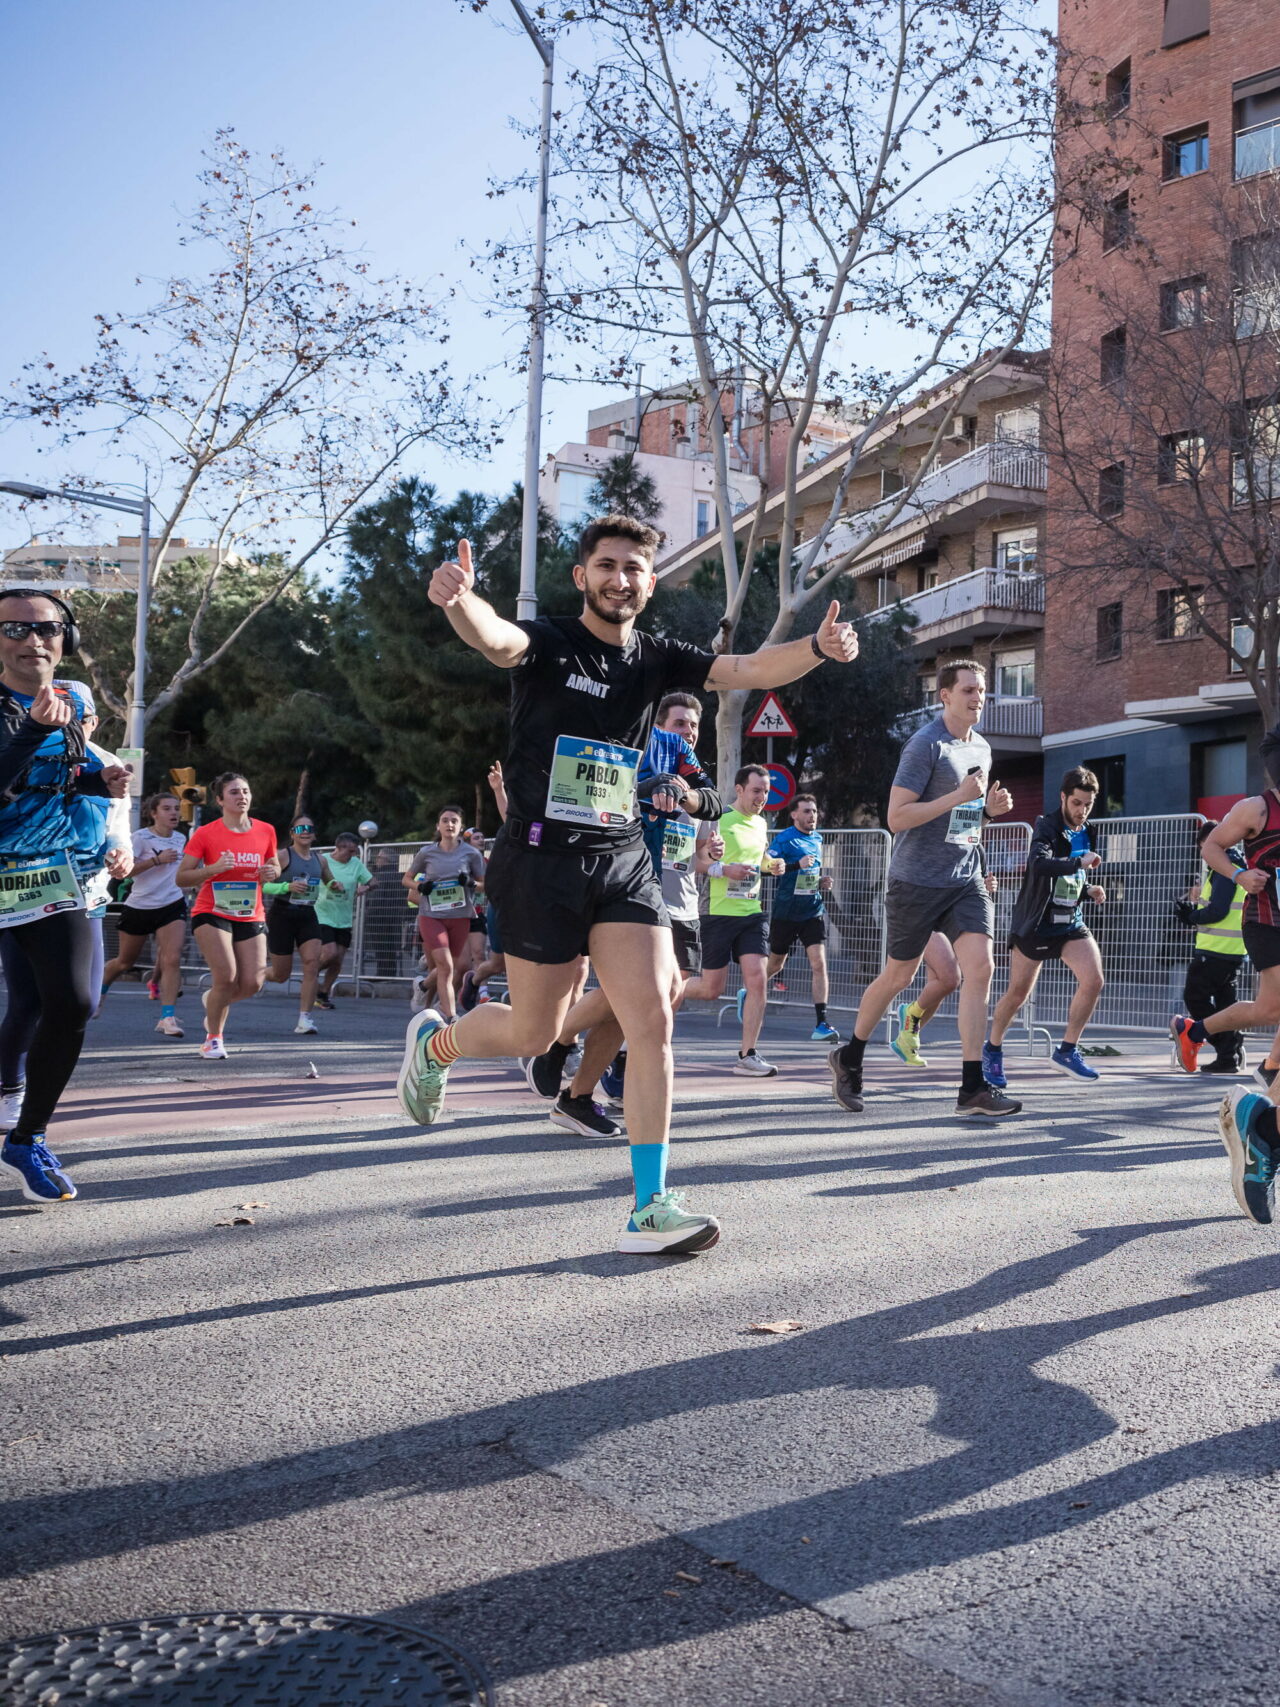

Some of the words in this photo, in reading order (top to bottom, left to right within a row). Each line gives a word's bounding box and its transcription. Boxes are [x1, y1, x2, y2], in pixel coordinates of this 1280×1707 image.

[575, 762, 619, 787] PABLO
[585, 785, 607, 799] 11333
[565, 809, 594, 819] BROOKS
[7, 912, 37, 923] BROOKS
